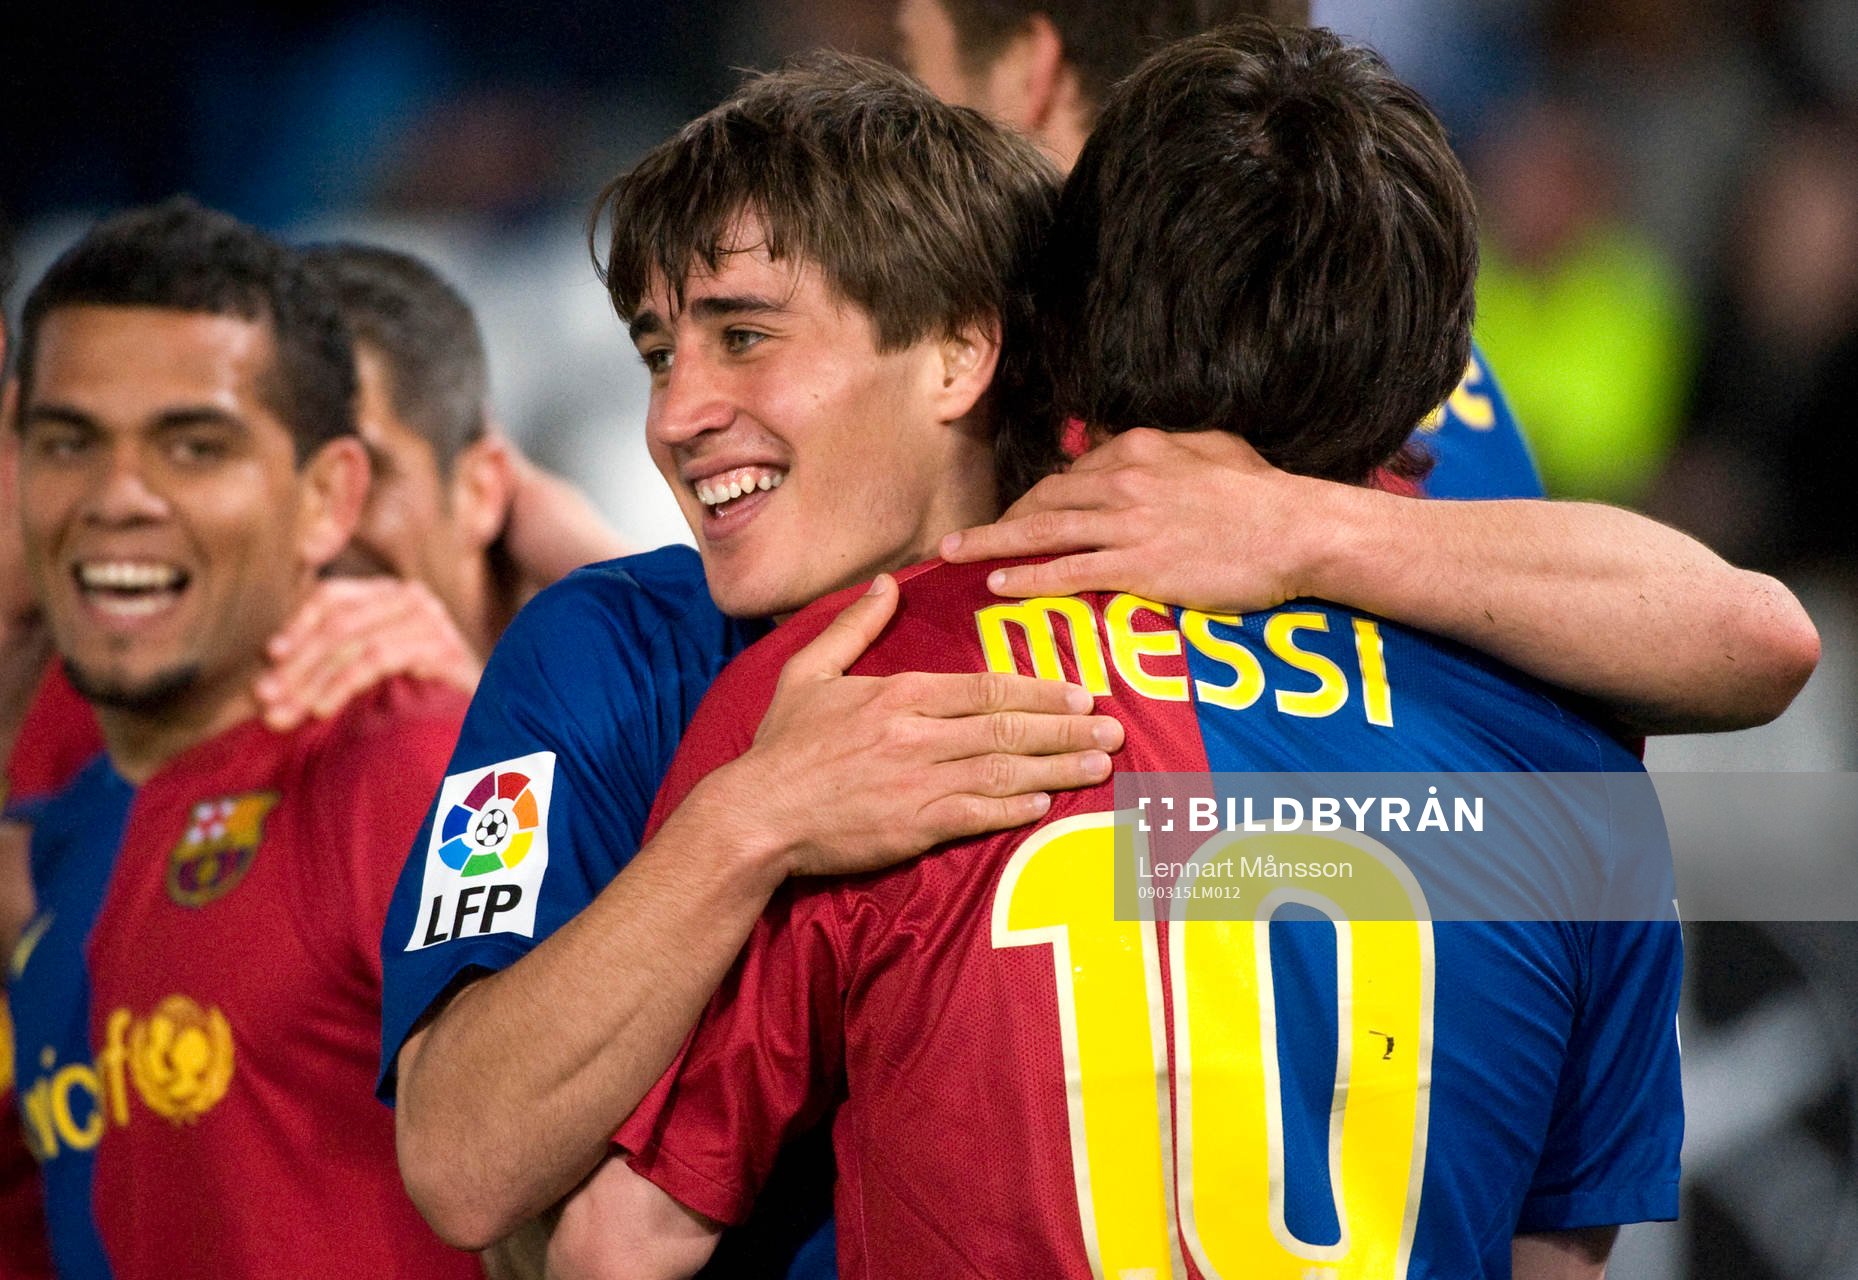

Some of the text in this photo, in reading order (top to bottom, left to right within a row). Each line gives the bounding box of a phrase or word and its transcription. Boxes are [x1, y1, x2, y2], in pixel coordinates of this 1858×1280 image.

[974, 593, 1394, 728] MESSI
[422, 883, 523, 946] LFP
[990, 809, 1436, 1280] 10
